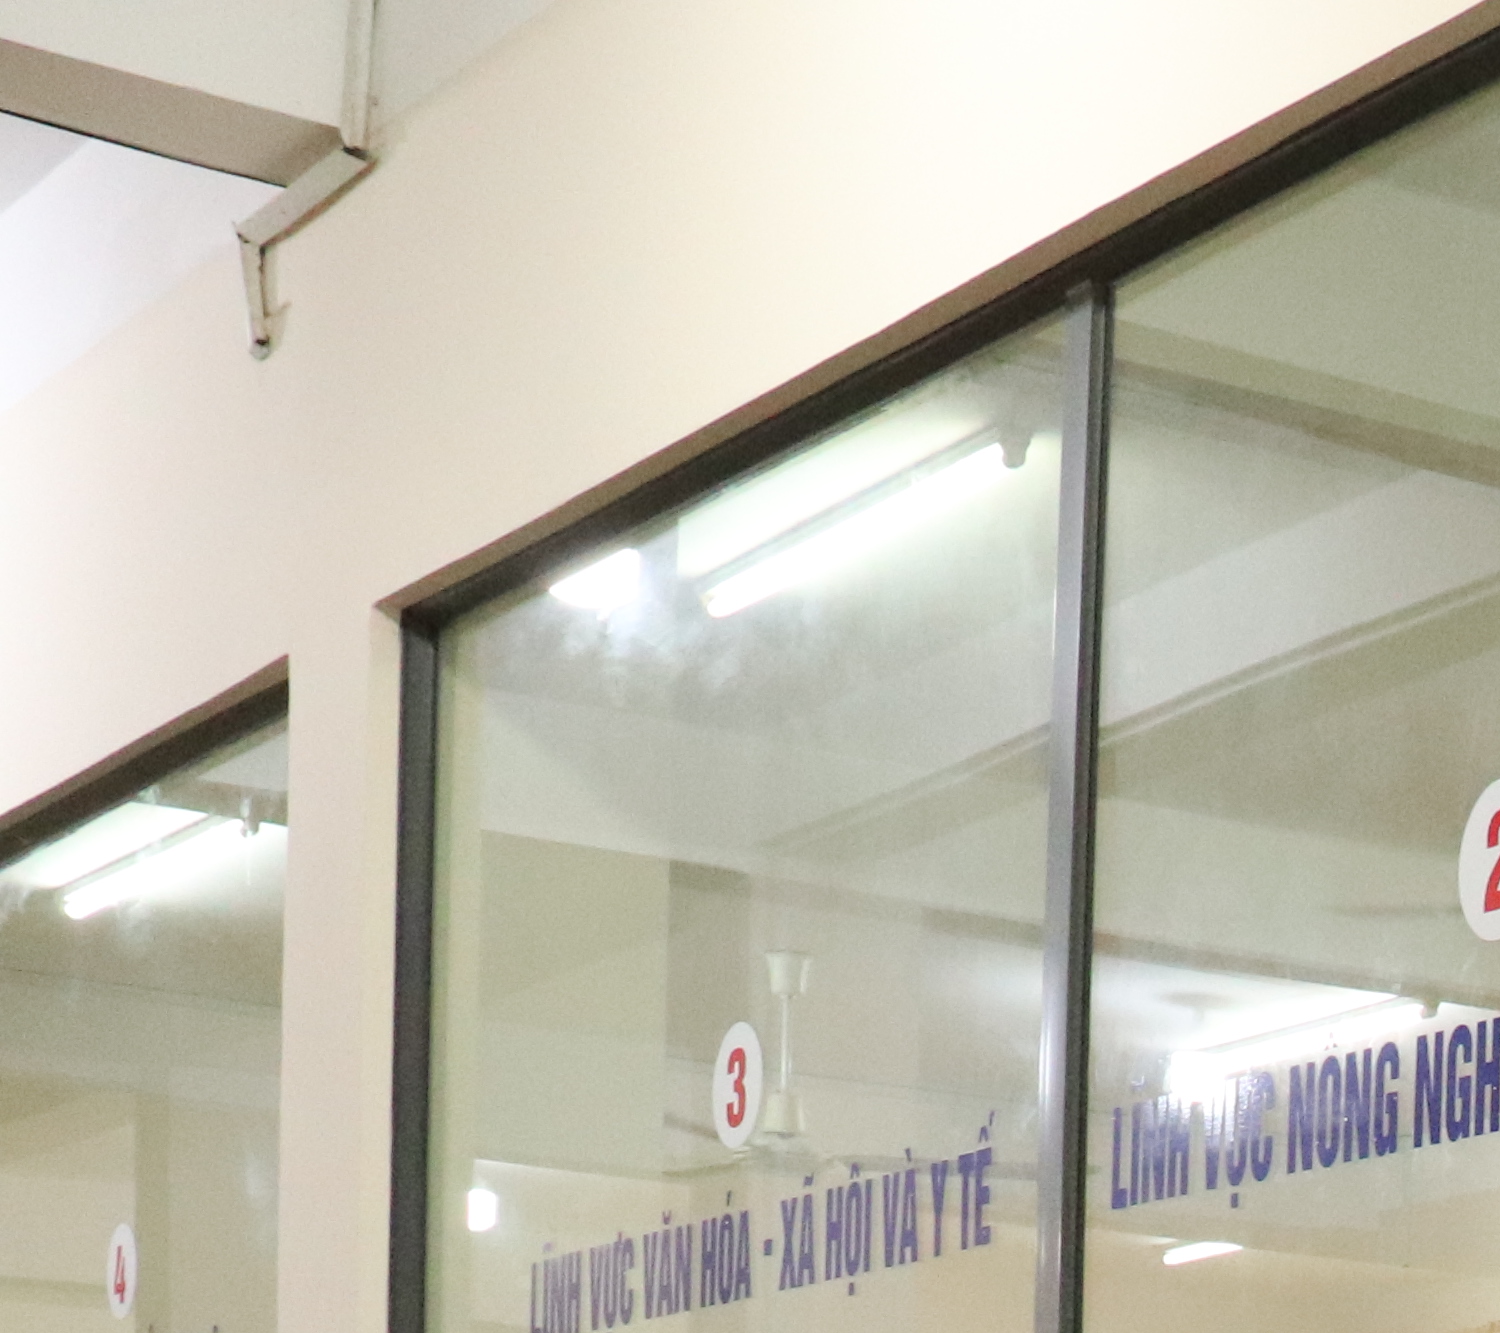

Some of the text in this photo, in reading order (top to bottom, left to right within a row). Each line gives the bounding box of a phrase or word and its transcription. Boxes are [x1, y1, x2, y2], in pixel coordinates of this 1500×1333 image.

[725, 1046, 747, 1129] 3
[1287, 1032, 1399, 1174] NÔNG
[643, 1213, 692, 1319] VĂN
[700, 1192, 751, 1307] HÓA
[777, 1173, 815, 1290] XÃ
[825, 1161, 872, 1296] HỘI
[881, 1149, 918, 1265] VÀ
[931, 1159, 948, 1258] Y
[957, 1110, 994, 1247] TẾ
[112, 1247, 126, 1303] 4
